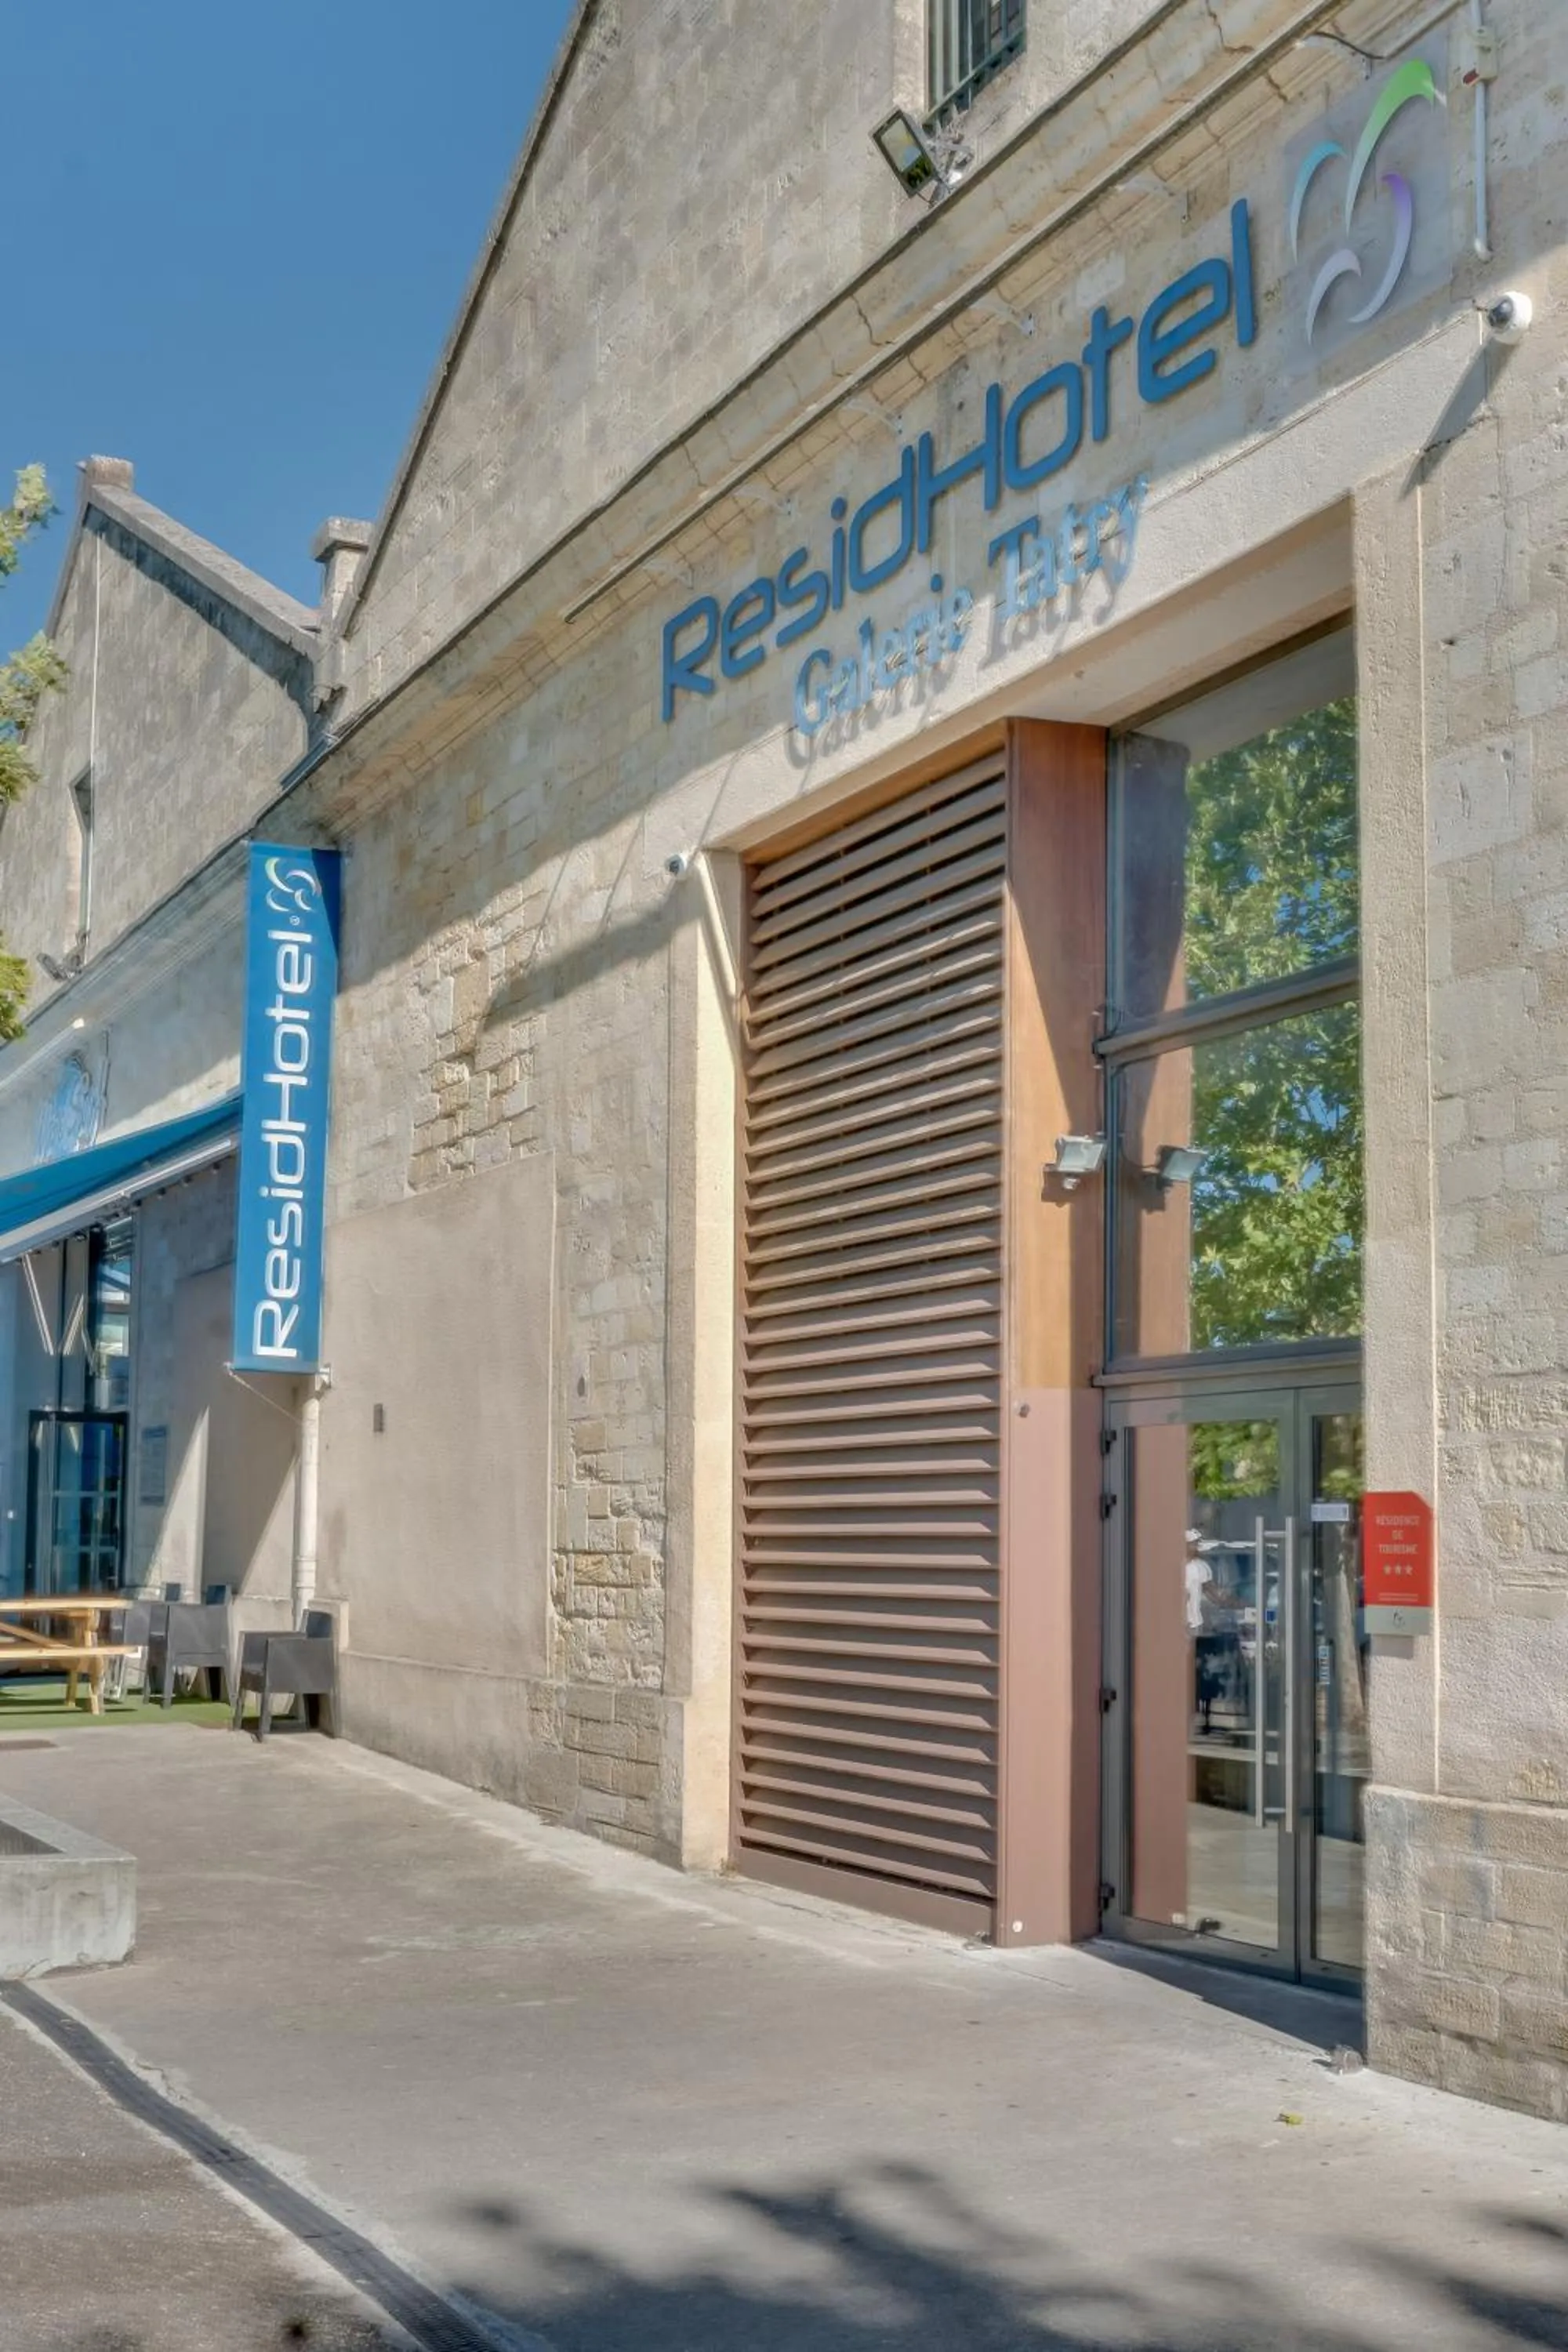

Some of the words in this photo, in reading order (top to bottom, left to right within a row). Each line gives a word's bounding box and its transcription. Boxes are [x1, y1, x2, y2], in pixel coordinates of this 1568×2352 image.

[662, 198, 1254, 723] ResidHotel
[793, 574, 973, 736] Galerie
[252, 930, 313, 1359] ResidHotel
